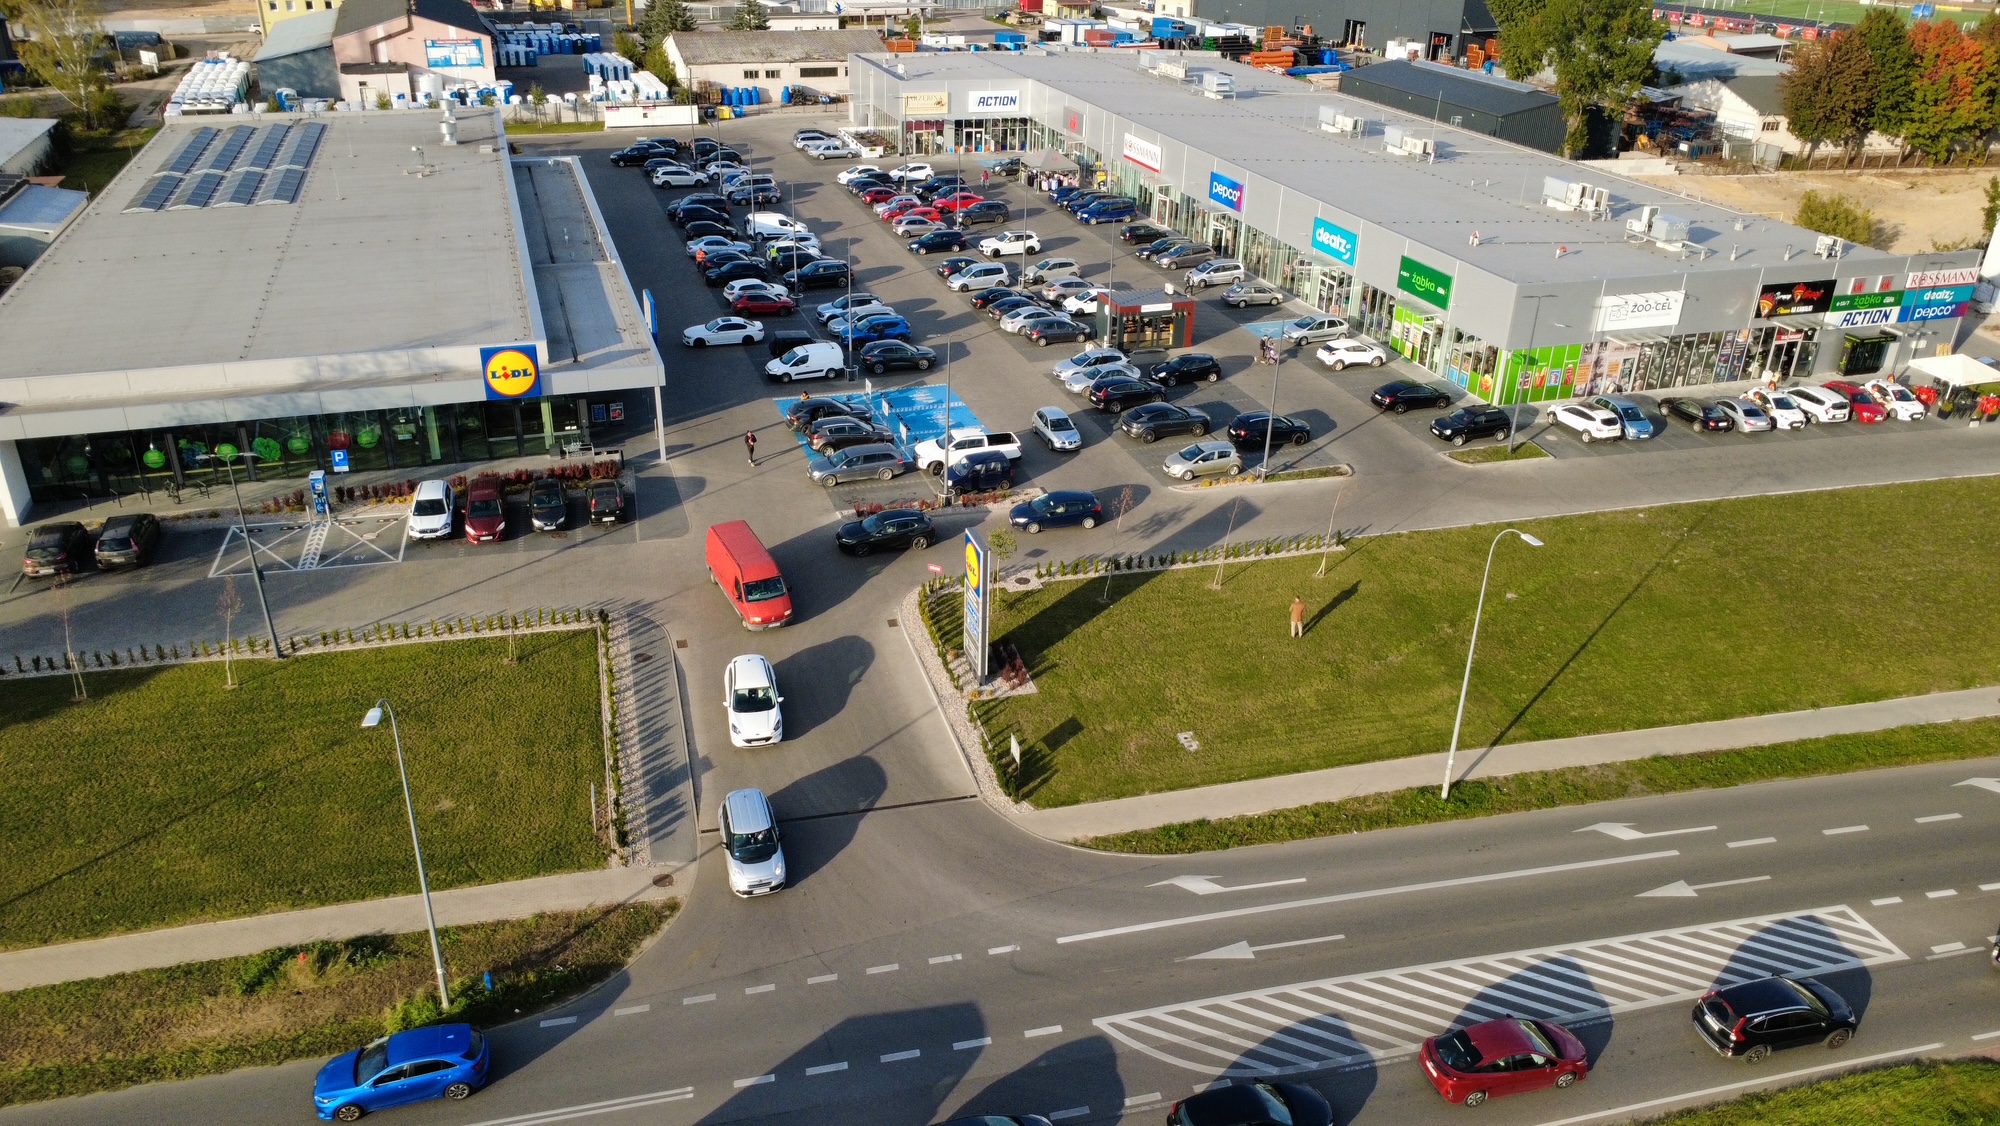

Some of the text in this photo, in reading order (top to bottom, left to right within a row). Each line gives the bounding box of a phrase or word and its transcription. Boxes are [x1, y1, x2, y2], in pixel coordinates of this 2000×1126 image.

[977, 96, 1018, 107] ACTION
[1124, 138, 1160, 164] ROSSMANN
[1212, 181, 1239, 203] pepco
[1315, 226, 1350, 257] dealz
[1411, 271, 1436, 292] żabka
[1911, 270, 1978, 287] ROSSMANN
[1853, 294, 1883, 306] żabka
[1923, 289, 1955, 302] dealz
[1839, 309, 1893, 327] ACTION
[1913, 306, 1952, 320] pepco
